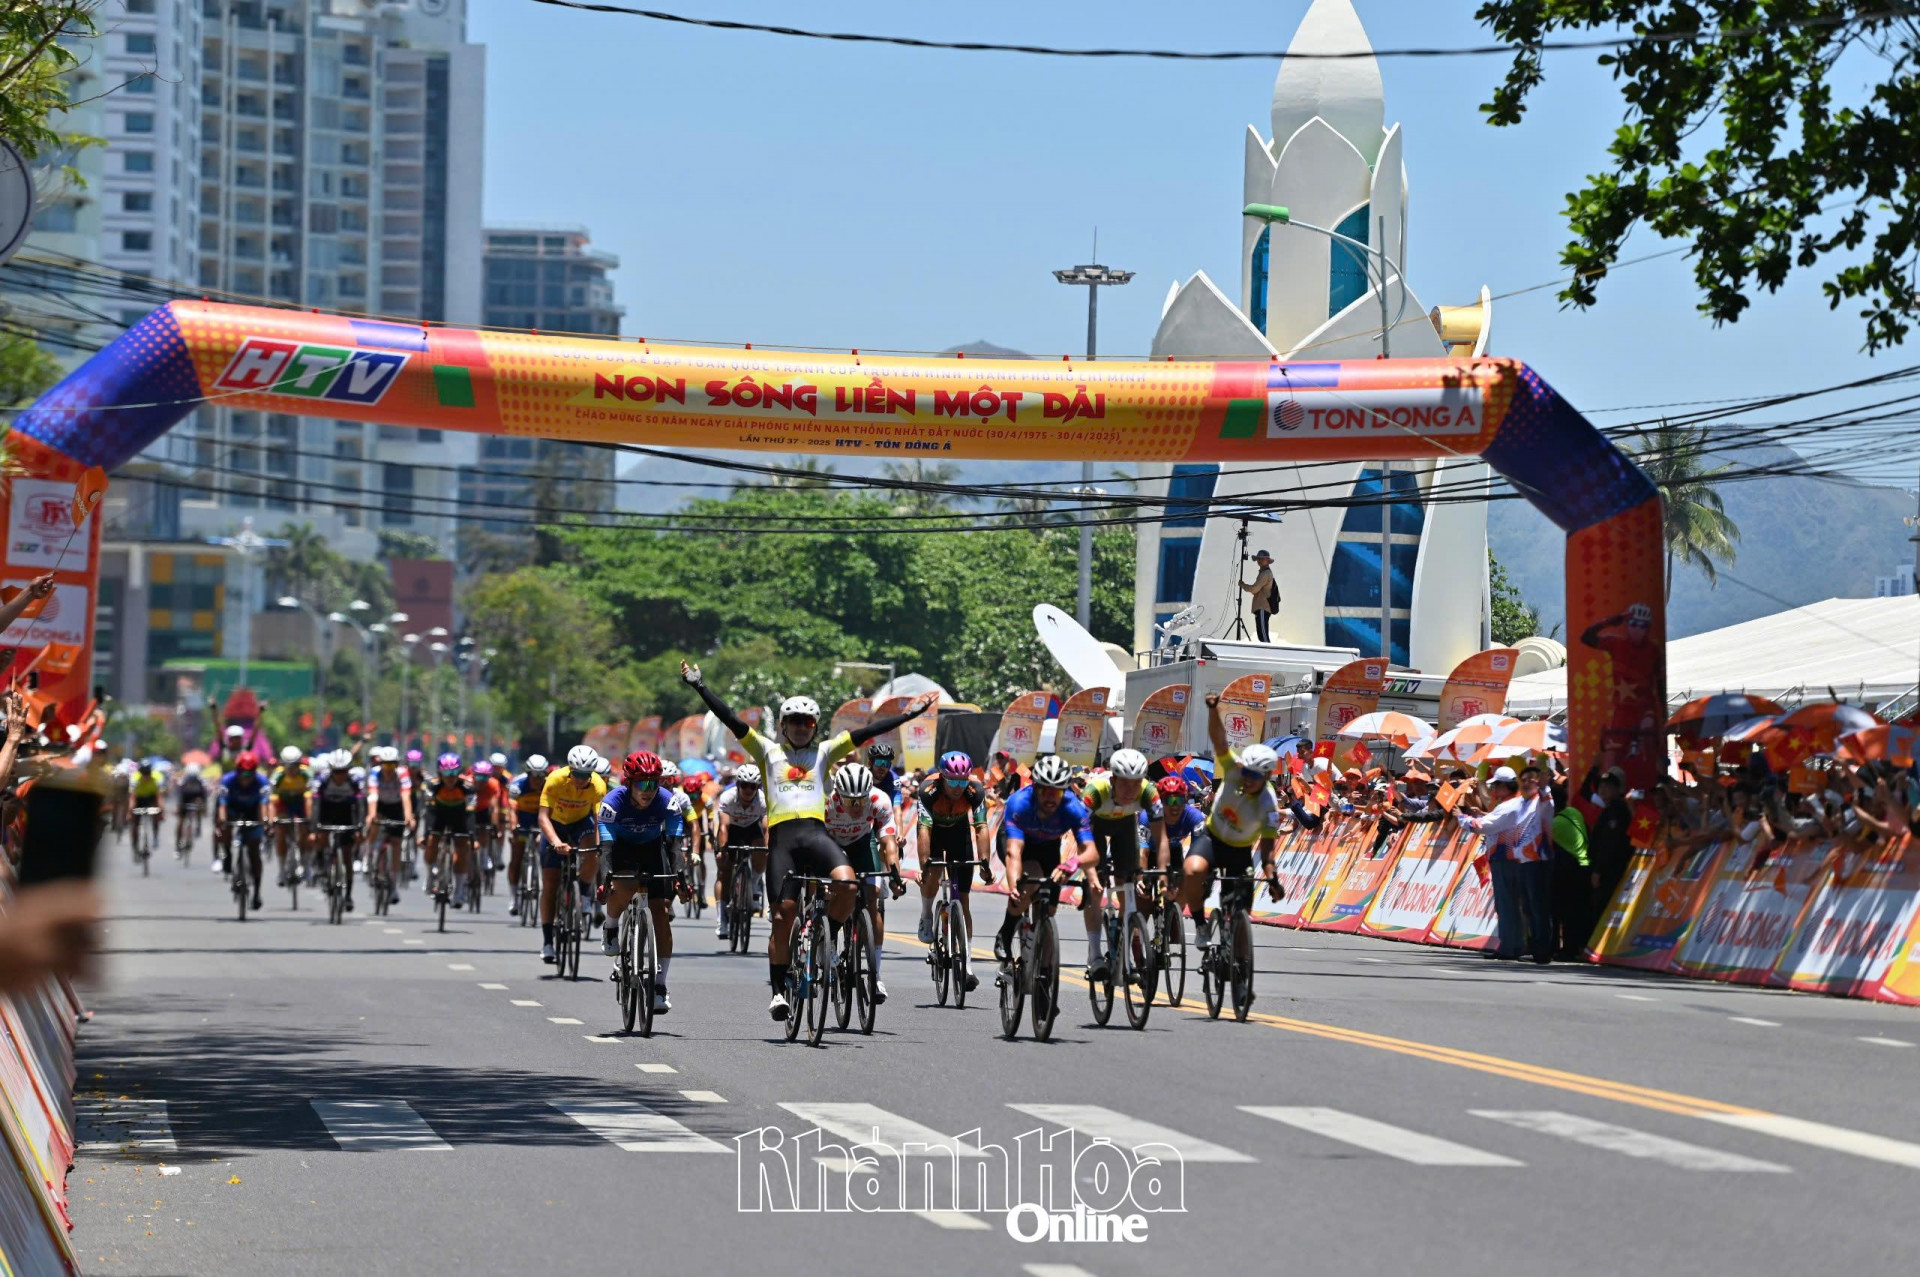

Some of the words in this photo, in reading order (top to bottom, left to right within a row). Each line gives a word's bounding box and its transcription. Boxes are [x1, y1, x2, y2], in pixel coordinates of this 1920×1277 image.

[229, 345, 398, 396] HTV
[1107, 374, 1146, 383] MINH
[593, 373, 686, 405] NON
[704, 375, 818, 417] SÔNG
[834, 376, 916, 415] LIỀN
[933, 384, 1024, 424] MỘT
[1042, 385, 1106, 424] DẢI
[1308, 407, 1367, 430] TON
[1370, 406, 1451, 429] DONG
[1454, 405, 1476, 427] A
[645, 415, 658, 424] 50
[724, 418, 748, 429] GIẢI
[750, 420, 790, 431] PHÓNG
[793, 421, 821, 432] MIỀN
[824, 425, 850, 434] NAM
[853, 423, 891, 435] THỐNG
[894, 425, 925, 436] NHẤT
[928, 425, 951, 437] ĐẤT
[953, 426, 984, 438] NƯỚC
[986, 430, 1047, 440] (30/4/1975
[1057, 431, 1120, 441] 30/4/2025)
[739, 434, 760, 443] LẦN
[764, 436, 785, 444] THỨ
[835, 439, 862, 447] HTV
[874, 439, 901, 449] TÔN
[1382, 678, 1421, 693] HTV
